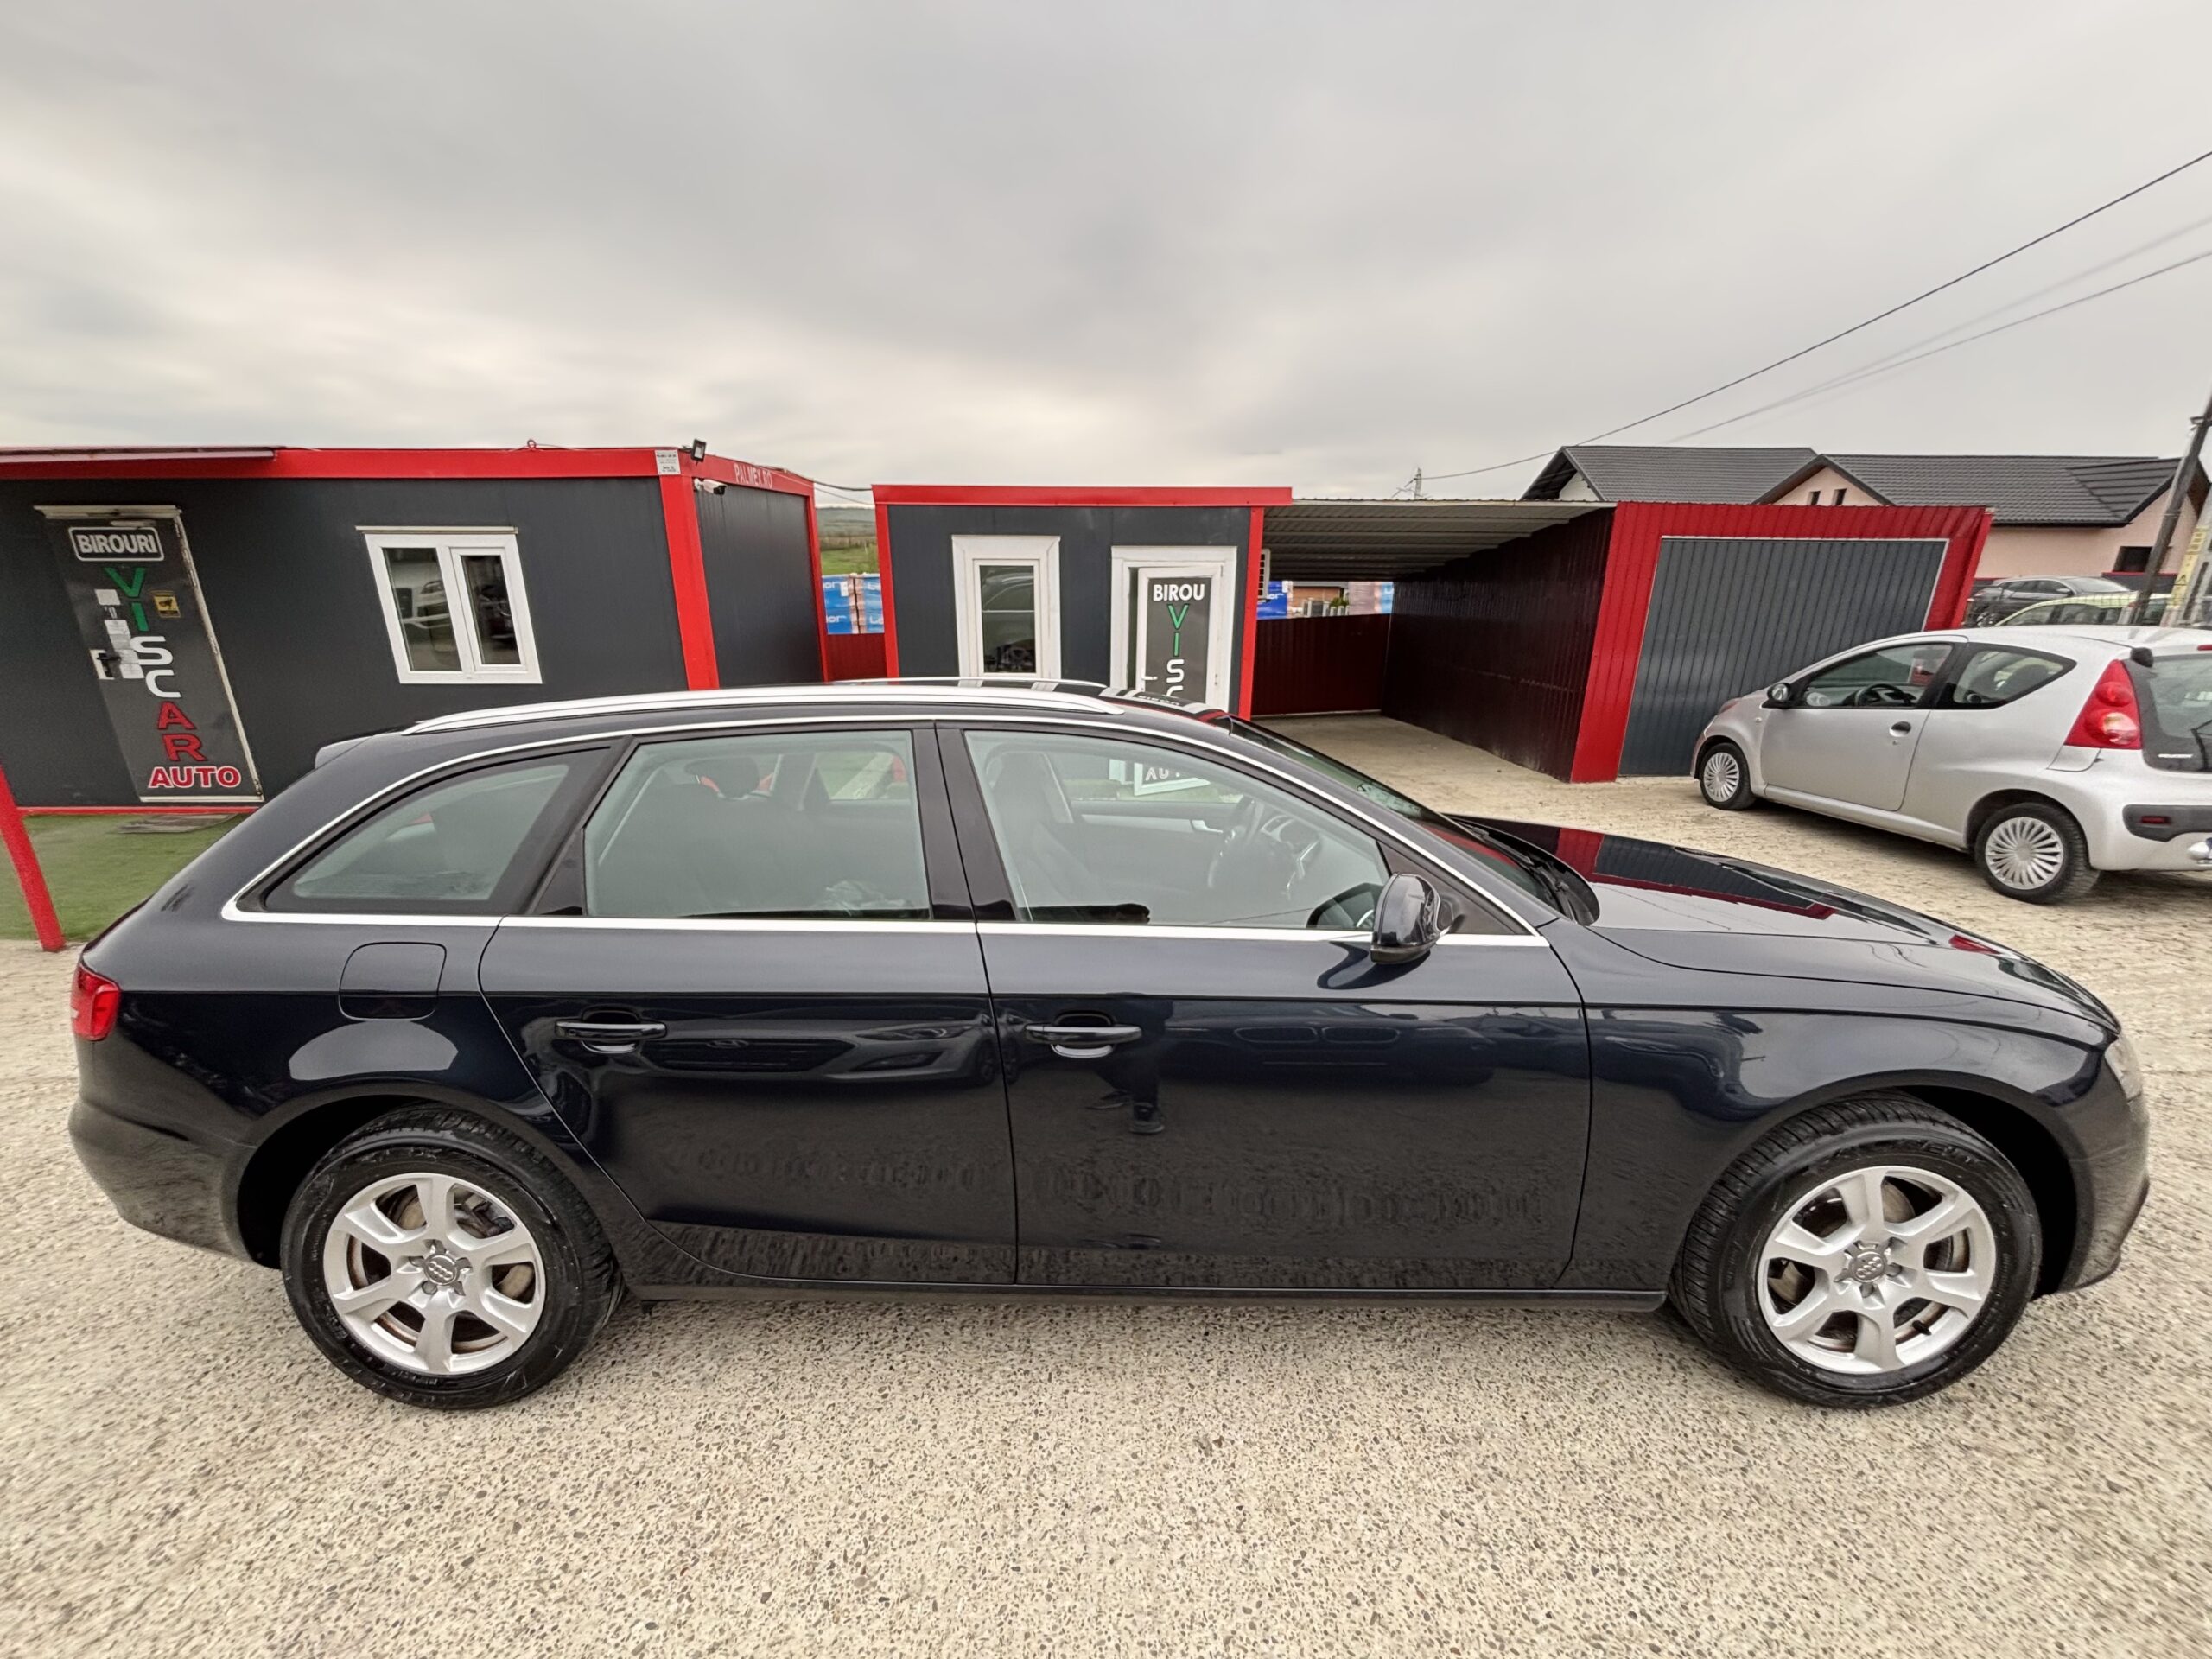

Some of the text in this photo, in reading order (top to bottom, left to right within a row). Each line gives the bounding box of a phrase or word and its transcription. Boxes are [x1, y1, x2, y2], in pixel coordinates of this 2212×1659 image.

[75, 534, 159, 555] BIROURI
[1153, 583, 1205, 601] BIROU
[147, 765, 242, 789] AUTO
